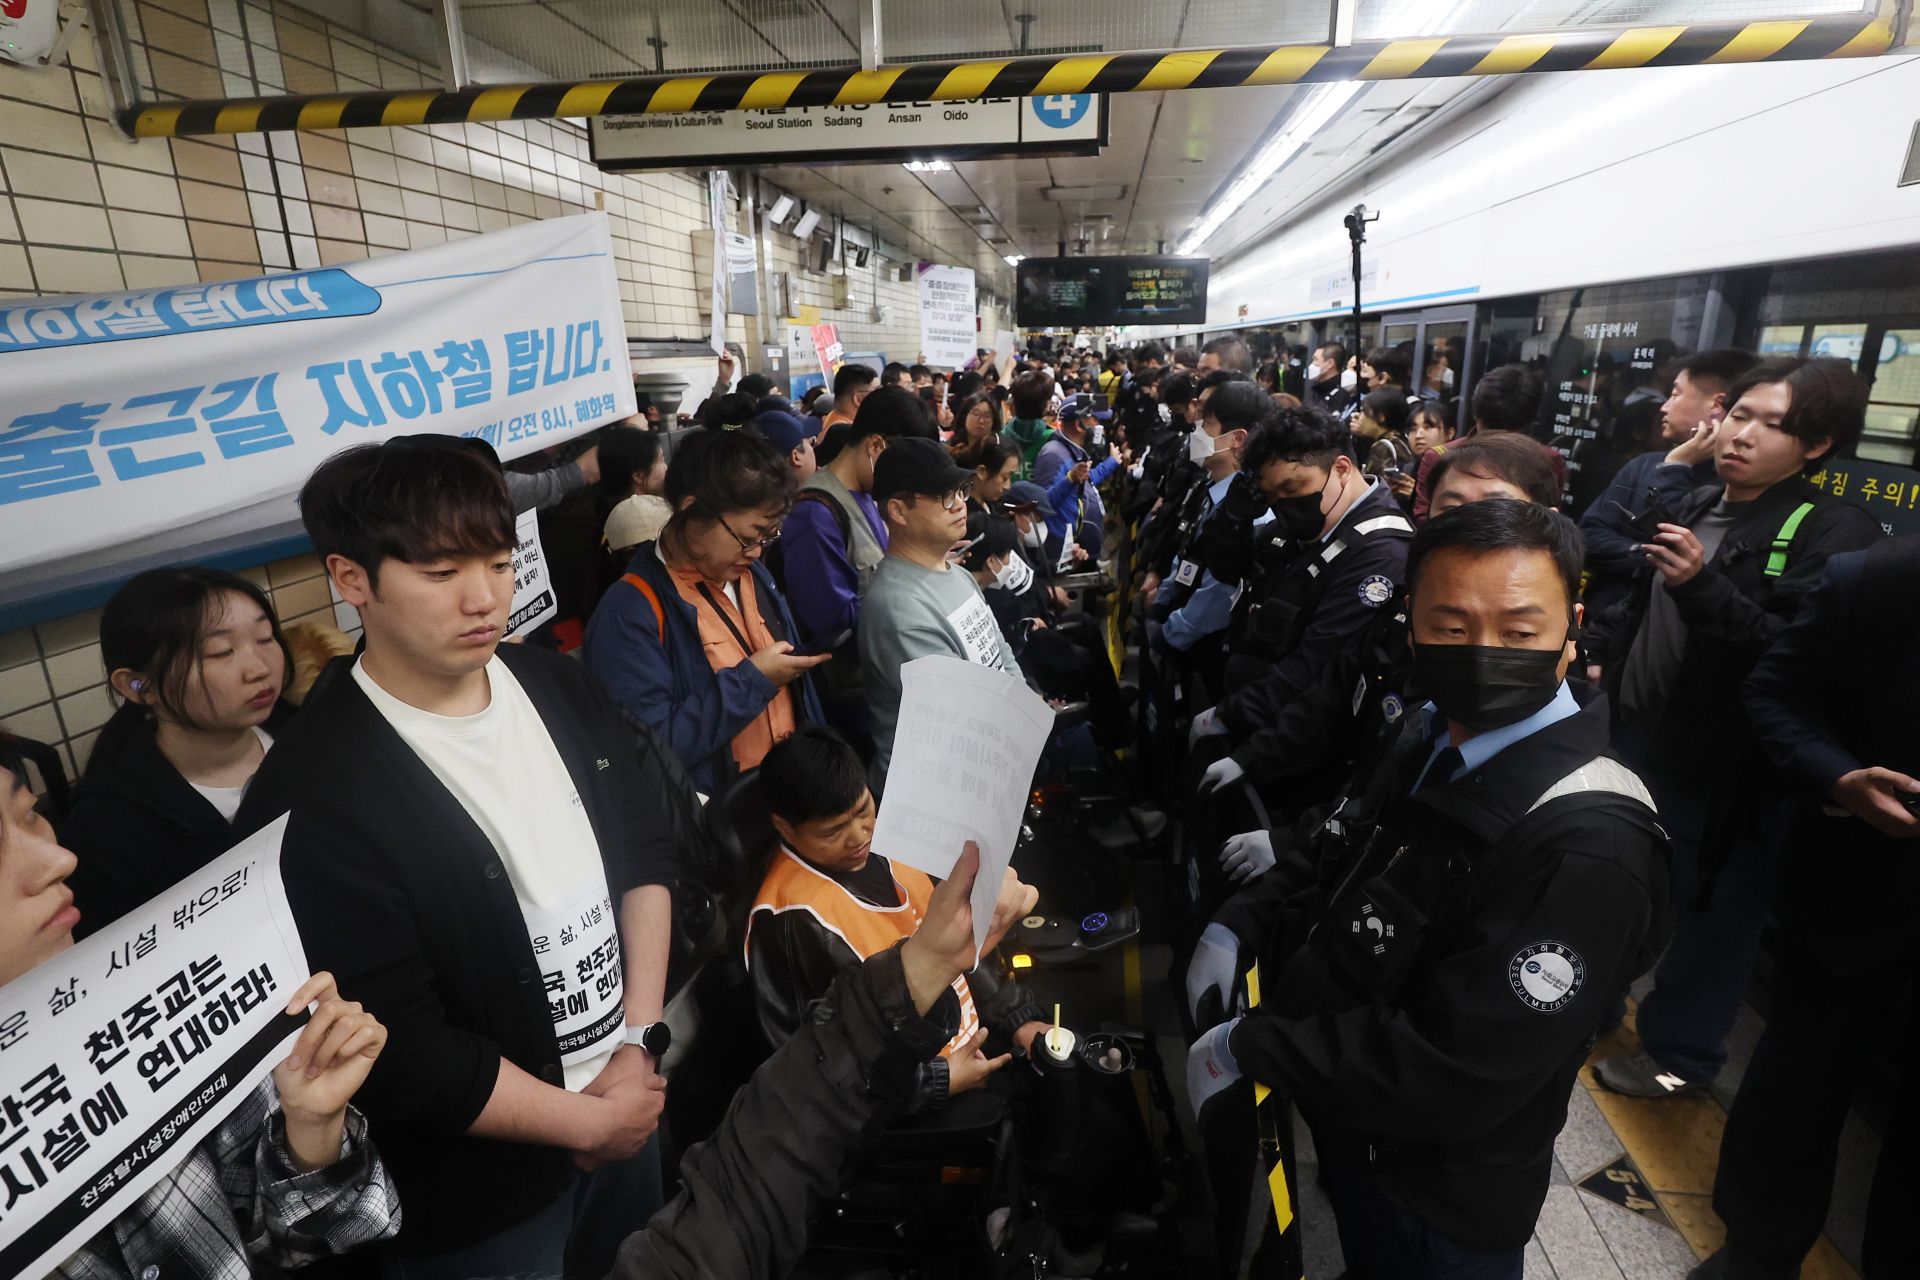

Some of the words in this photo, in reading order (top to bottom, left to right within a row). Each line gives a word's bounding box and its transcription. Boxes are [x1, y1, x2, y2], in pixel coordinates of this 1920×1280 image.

[888, 113, 922, 124] Ansan
[943, 109, 969, 121] Oido
[1043, 93, 1076, 119] 4
[603, 119, 648, 131] Dongdaemun
[649, 118, 674, 130] History
[674, 117, 680, 127] &
[681, 117, 706, 127] Culture
[707, 116, 724, 126] Park
[745, 118, 774, 130] Seoul
[776, 117, 813, 129] Station
[823, 115, 863, 128] Sadang
[162, 276, 330, 328] 탑니다
[0, 372, 295, 505] 출근길
[306, 339, 492, 437] 지하철
[504, 320, 611, 396] 탑니다.
[508, 412, 539, 443] 오전
[542, 405, 573, 431] 8시,
[574, 393, 616, 421] 혜화역
[1861, 478, 1920, 509] 주의!
[1881, 522, 1894, 536] 다.
[524, 549, 539, 564] 아닌
[523, 568, 539, 586] 살자!
[559, 924, 579, 946] 삶,
[580, 904, 603, 932] 시설
[48, 976, 88, 1017] 삶,
[105, 925, 158, 979] 시설
[82, 953, 228, 1074] 천주교는
[136, 962, 278, 1093] 연대하라!
[80, 1073, 229, 1210] 전국탈시설장애인연대
